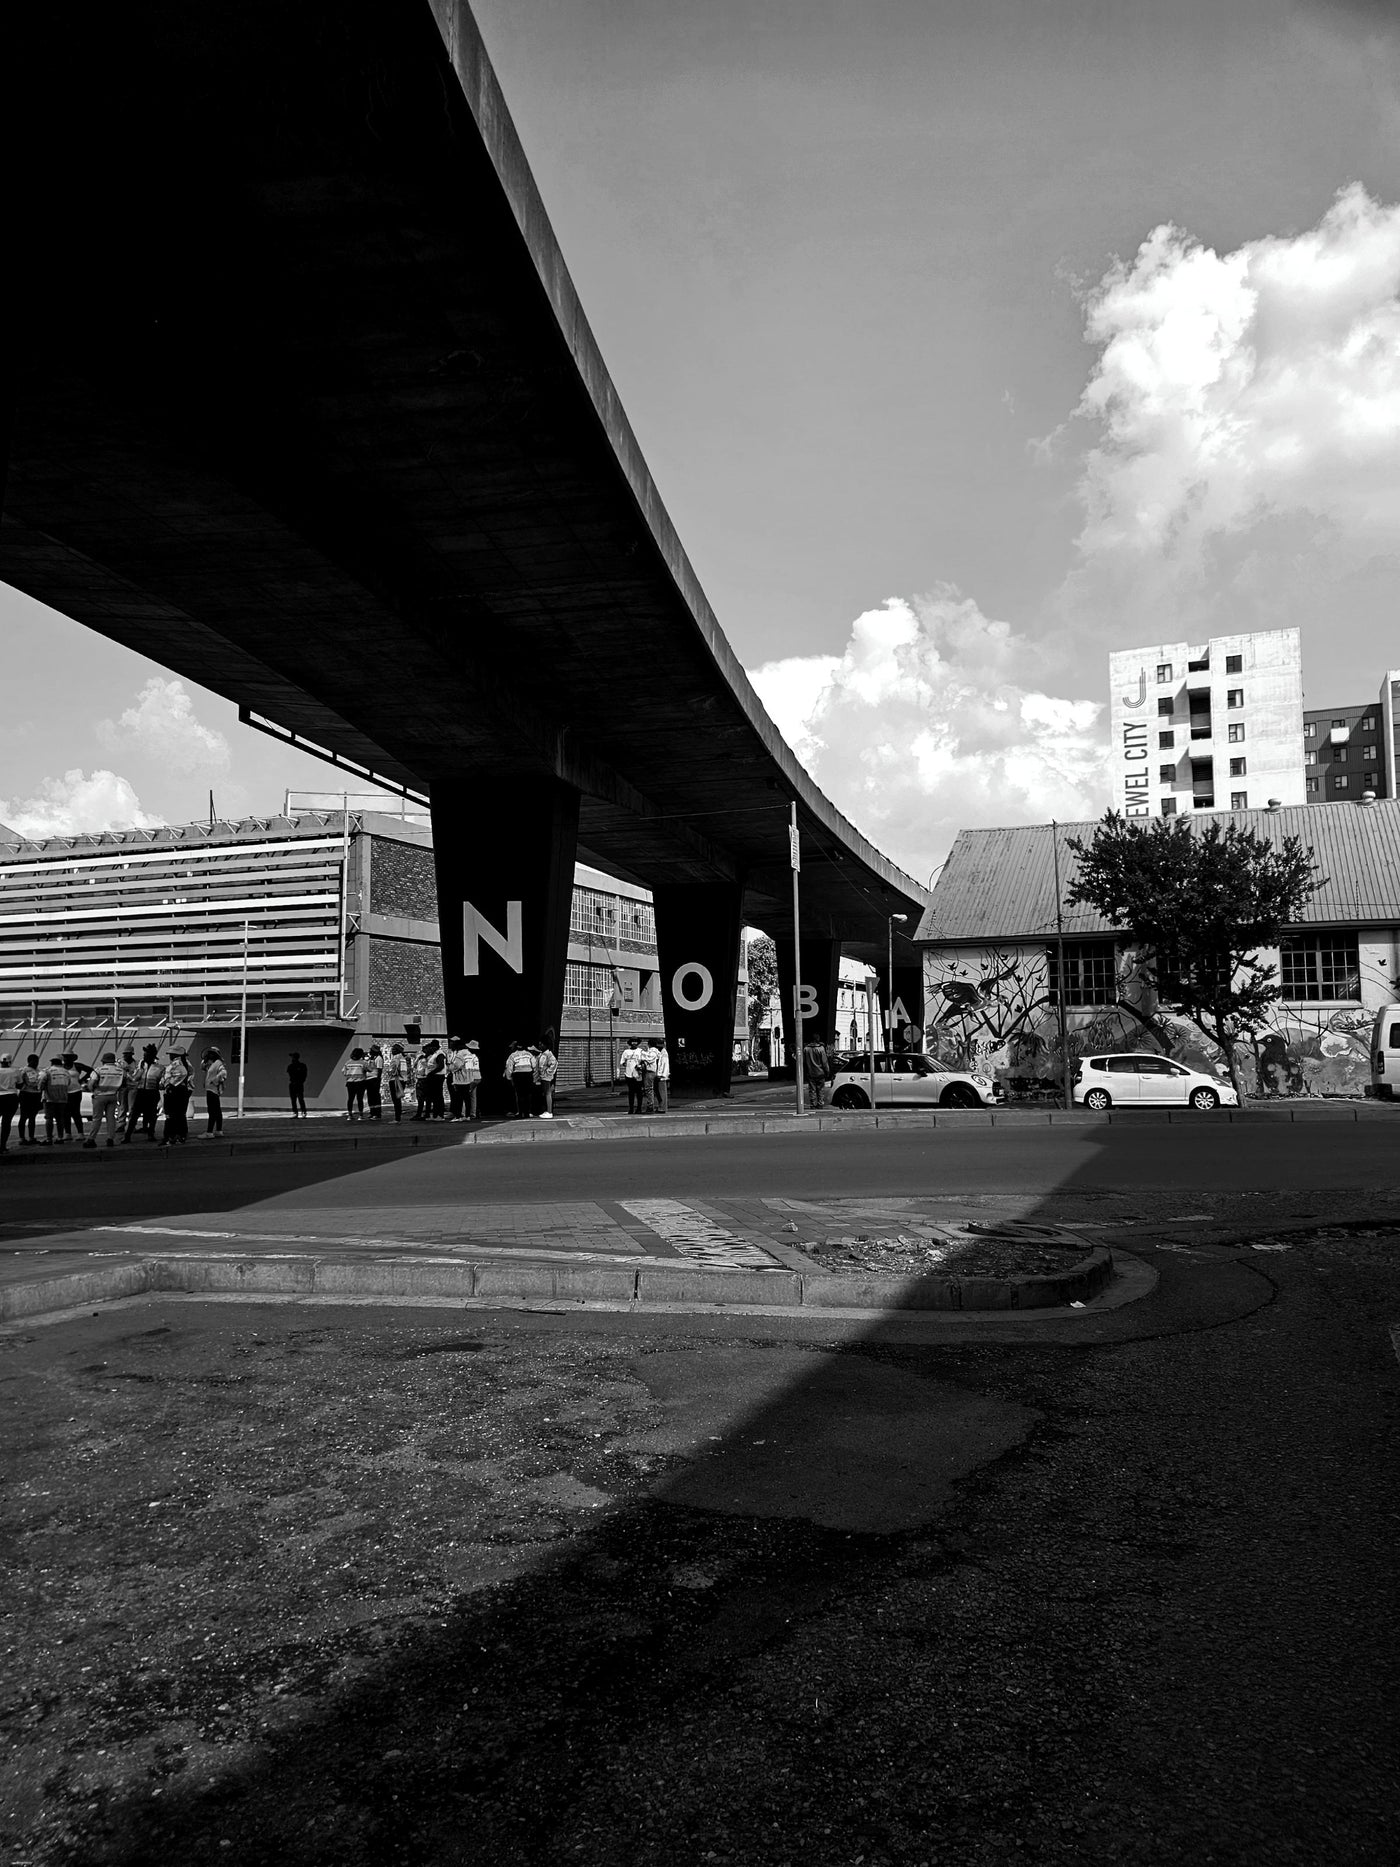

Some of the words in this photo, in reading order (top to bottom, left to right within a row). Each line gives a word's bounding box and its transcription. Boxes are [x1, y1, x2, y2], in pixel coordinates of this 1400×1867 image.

[1123, 722, 1148, 760] CITY
[1125, 767, 1149, 818] EWEL
[463, 901, 523, 976] N
[672, 962, 713, 1011] O
[793, 984, 820, 1019] B
[889, 996, 912, 1023] A
